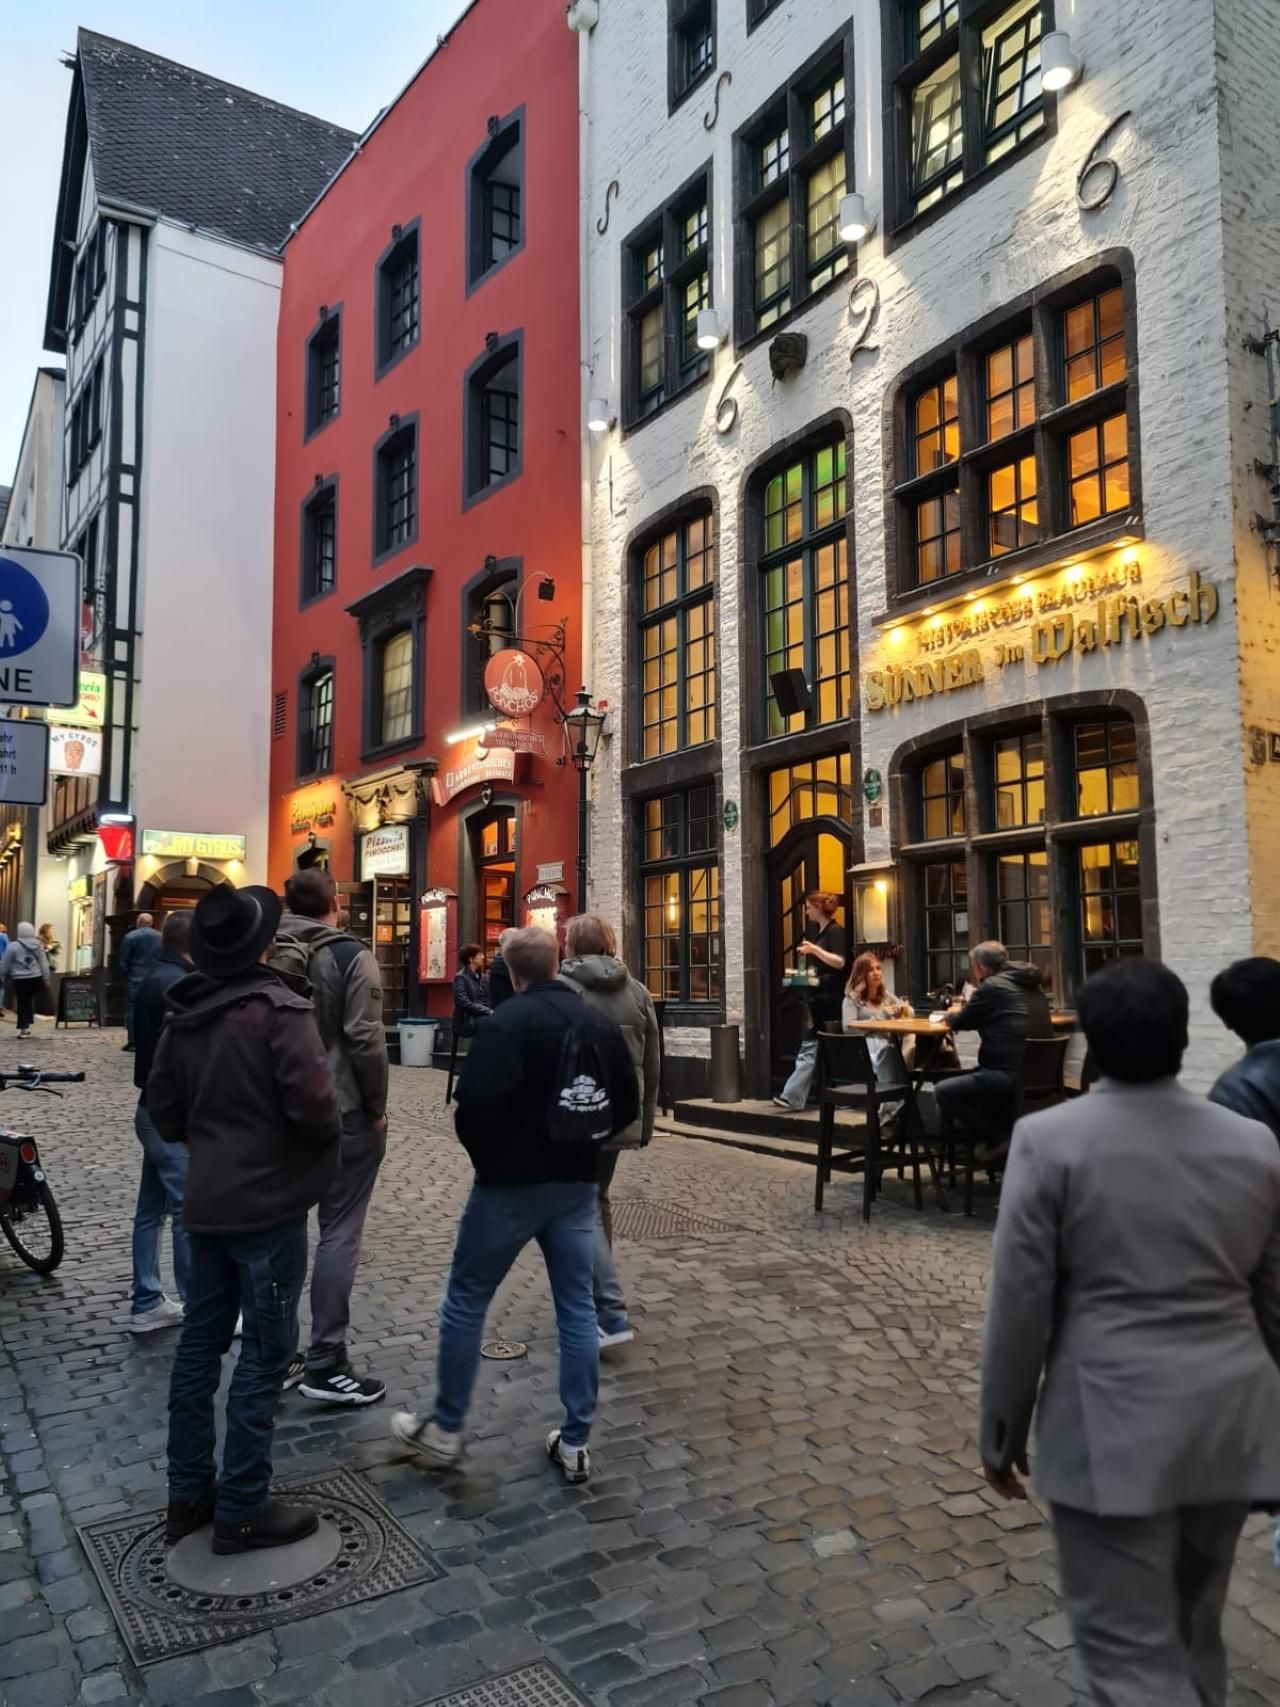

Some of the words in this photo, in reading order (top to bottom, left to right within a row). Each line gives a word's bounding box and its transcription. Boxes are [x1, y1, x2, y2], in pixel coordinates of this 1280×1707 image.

[716, 362, 744, 435] 6
[849, 278, 880, 362] 2
[1076, 110, 1130, 211] 6
[1037, 560, 1143, 614] BRAUHAUS
[866, 648, 984, 710] SÜNNER
[1031, 570, 1218, 663] Walfisch
[489, 686, 538, 713] PONCHOS
[172, 835, 195, 853] MY
[196, 837, 242, 856] GYROS
